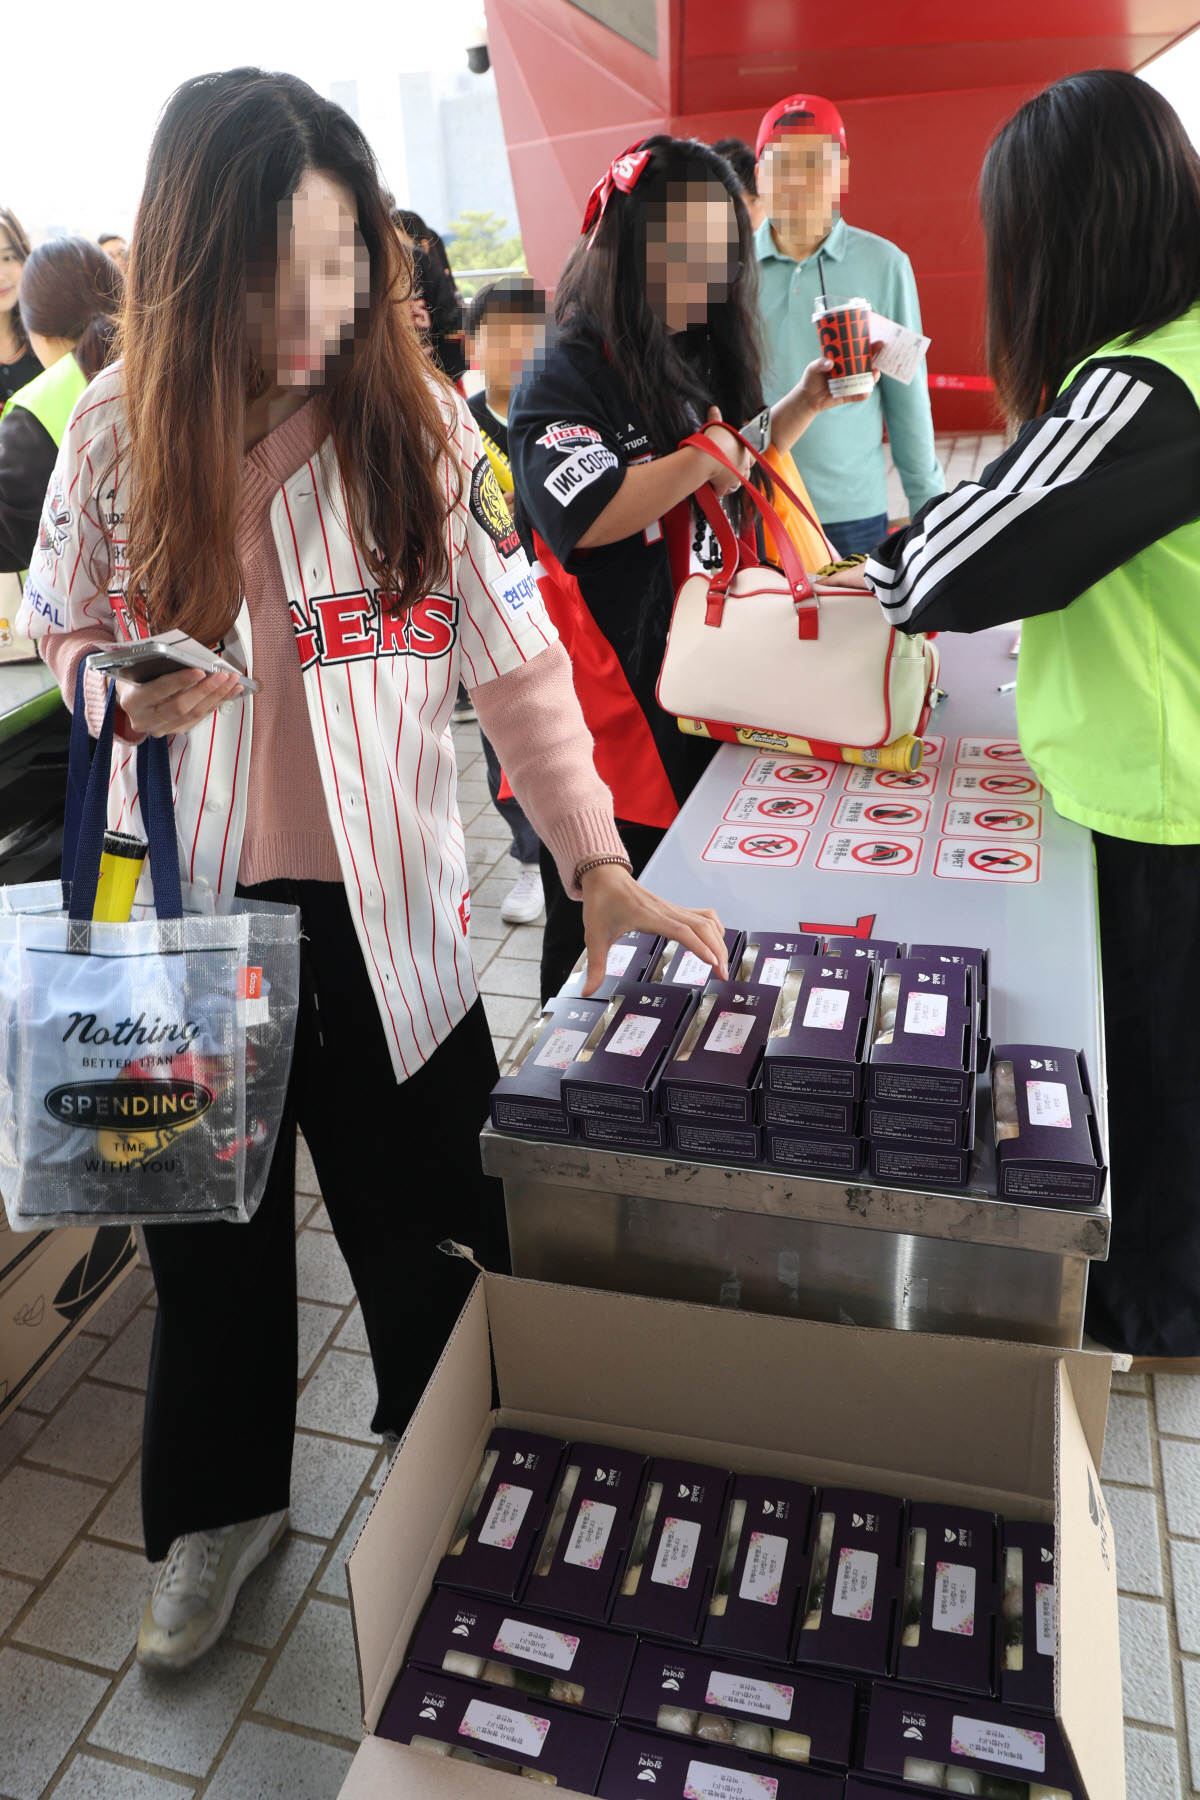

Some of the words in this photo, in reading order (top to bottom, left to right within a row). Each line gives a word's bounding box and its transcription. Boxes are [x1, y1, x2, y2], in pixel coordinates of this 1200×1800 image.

[538, 427, 600, 445] TIGERS
[249, 972, 258, 995] daiso
[62, 1011, 200, 1054] Nothing
[82, 1057, 132, 1068] BETTER
[139, 1056, 173, 1068] THAN
[60, 1092, 197, 1116] SPENDING
[113, 1142, 146, 1152] TIME
[85, 1161, 130, 1173] WITH
[139, 1160, 175, 1173] YOU
[499, 1501, 512, 1523] 감사합니다
[584, 1519, 596, 1542] 감사합니다
[670, 1537, 681, 1560] 감사합니다
[758, 1552, 769, 1576] 감사합니다
[850, 1568, 859, 1592] 감사합니다
[949, 1582, 957, 1607] 감사합니다
[509, 1641, 531, 1652] 행복했고
[518, 1636, 546, 1649] 감사합니다
[531, 1648, 555, 1659] 함께여서
[722, 1694, 745, 1704] 행복했고
[731, 1689, 760, 1700] 감사합니다
[747, 1700, 771, 1710] 함께여서
[476, 1725, 499, 1737] 행복했고
[485, 1719, 515, 1733] 감사합니다
[499, 1732, 524, 1745] 함께여서
[978, 1736, 1010, 1749] 감사합니다
[969, 1743, 994, 1754] 행복했고
[997, 1749, 1023, 1760] 함께여서
[711, 1781, 743, 1794] 감사합니다
